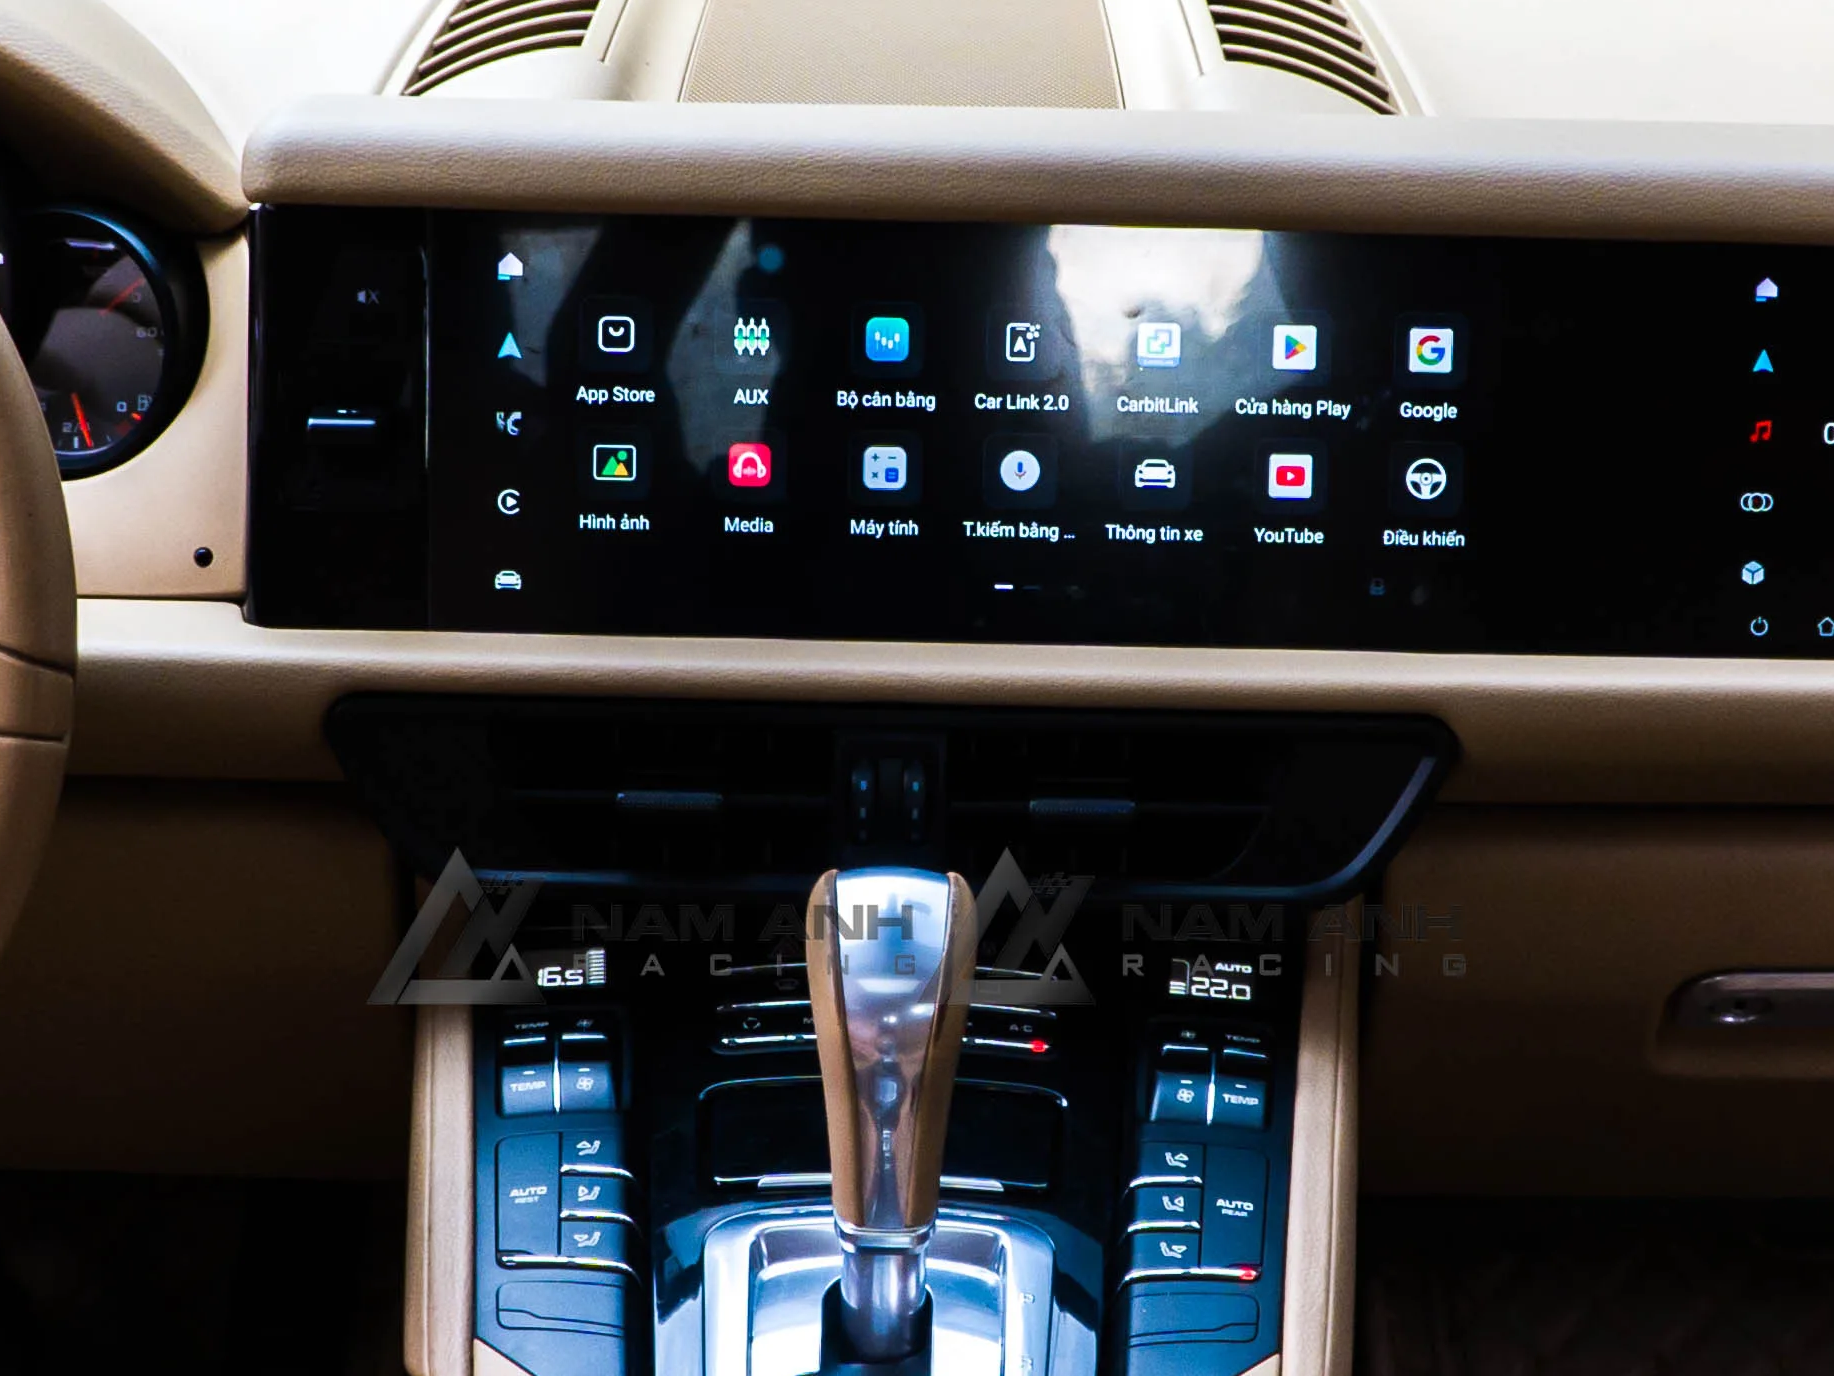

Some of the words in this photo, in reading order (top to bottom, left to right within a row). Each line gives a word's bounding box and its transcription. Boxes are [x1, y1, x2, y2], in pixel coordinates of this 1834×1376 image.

[576, 385, 608, 404] App
[612, 386, 656, 404] Store
[733, 389, 769, 405] AUX
[836, 390, 859, 410] Bộ
[862, 390, 893, 407] cân
[974, 393, 1003, 410] Car
[1006, 393, 1041, 411] Link
[1043, 394, 1070, 411] 2.0
[1116, 396, 1199, 414] CarbitLink
[1234, 396, 1268, 415] Cửa
[1272, 398, 1312, 419] hàng
[1316, 400, 1352, 420] Play
[1399, 402, 1458, 422] Google
[579, 513, 617, 531] Hình
[620, 513, 650, 531] ảnh
[723, 516, 774, 533] Media
[849, 518, 885, 539] Máy
[888, 519, 919, 536] tính
[962, 520, 1015, 538] T.kiếm
[1105, 523, 1155, 544] Thông
[1160, 524, 1181, 541] tin
[1184, 528, 1204, 542] xe
[1253, 527, 1325, 545] YouTube
[1382, 528, 1419, 546] Điều
[1215, 962, 1253, 974] AUTO
[1190, 976, 1252, 1001] 22.0
[509, 1080, 547, 1093] TEMP
[1222, 1092, 1260, 1106] TEMP
[508, 1186, 548, 1197] AUTO
[1216, 1198, 1254, 1211] AUTO
